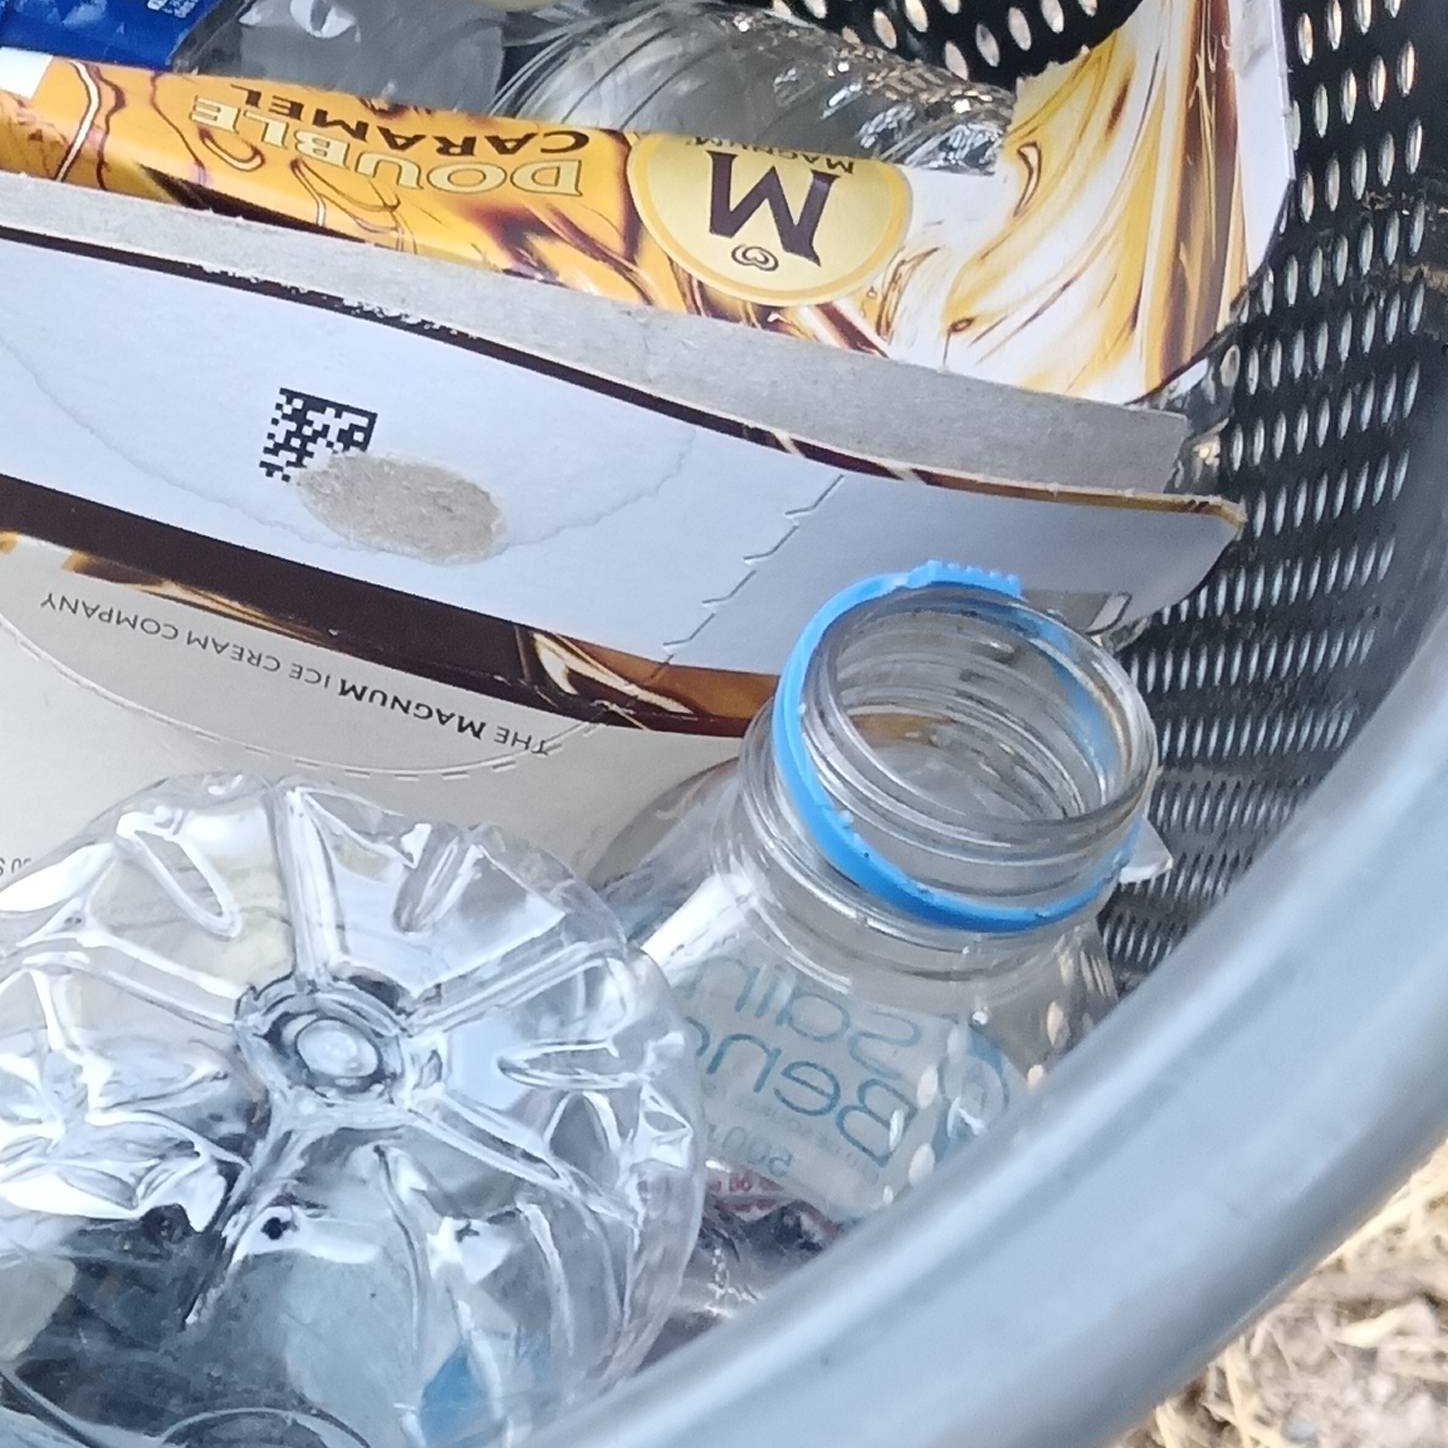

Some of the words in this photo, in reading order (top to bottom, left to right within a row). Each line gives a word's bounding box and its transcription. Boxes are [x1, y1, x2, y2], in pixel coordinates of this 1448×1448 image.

[189, 93, 583, 198] DOUBLE
[230, 82, 590, 157] CARAMEL
[706, 150, 841, 268] M
[40, 590, 180, 643] COMPANY
[185, 629, 283, 671] CREAM
[289, 660, 332, 689] ICE
[338, 679, 488, 740] MAGNUM
[495, 724, 550, 756] THE
